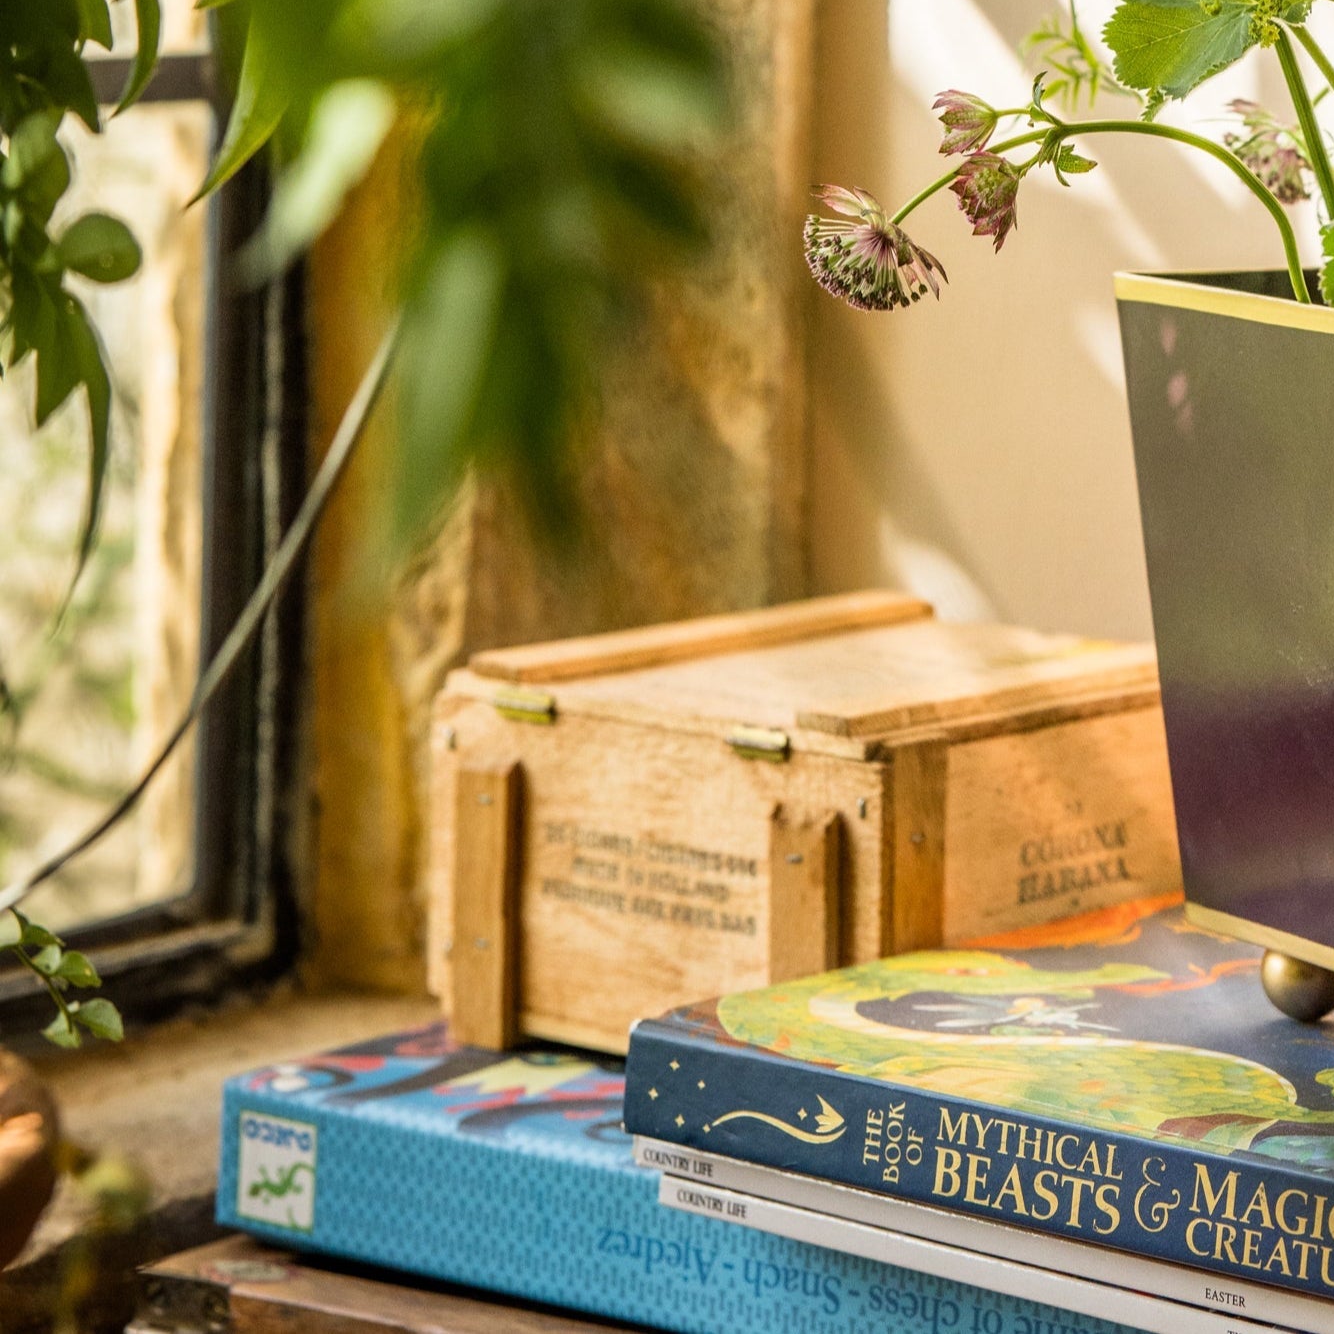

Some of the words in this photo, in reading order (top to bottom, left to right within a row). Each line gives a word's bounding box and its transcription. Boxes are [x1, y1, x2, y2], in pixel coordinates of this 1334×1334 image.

[643, 1147, 690, 1175] COUNTRY
[692, 1162, 713, 1179] LIFE
[862, 1108, 884, 1166] THE
[882, 1101, 906, 1185] BOOK
[905, 1126, 924, 1166] OF
[936, 1107, 1124, 1180] MYTHICAL
[676, 1187, 724, 1213] COUNTRY
[727, 1202, 748, 1218] LIFE
[931, 1146, 1121, 1235] BEASTS
[1134, 1156, 1181, 1233] &
[598, 1228, 717, 1287] Ajedrez
[868, 1285, 960, 1334] chess
[1205, 1287, 1246, 1309] EASTER
